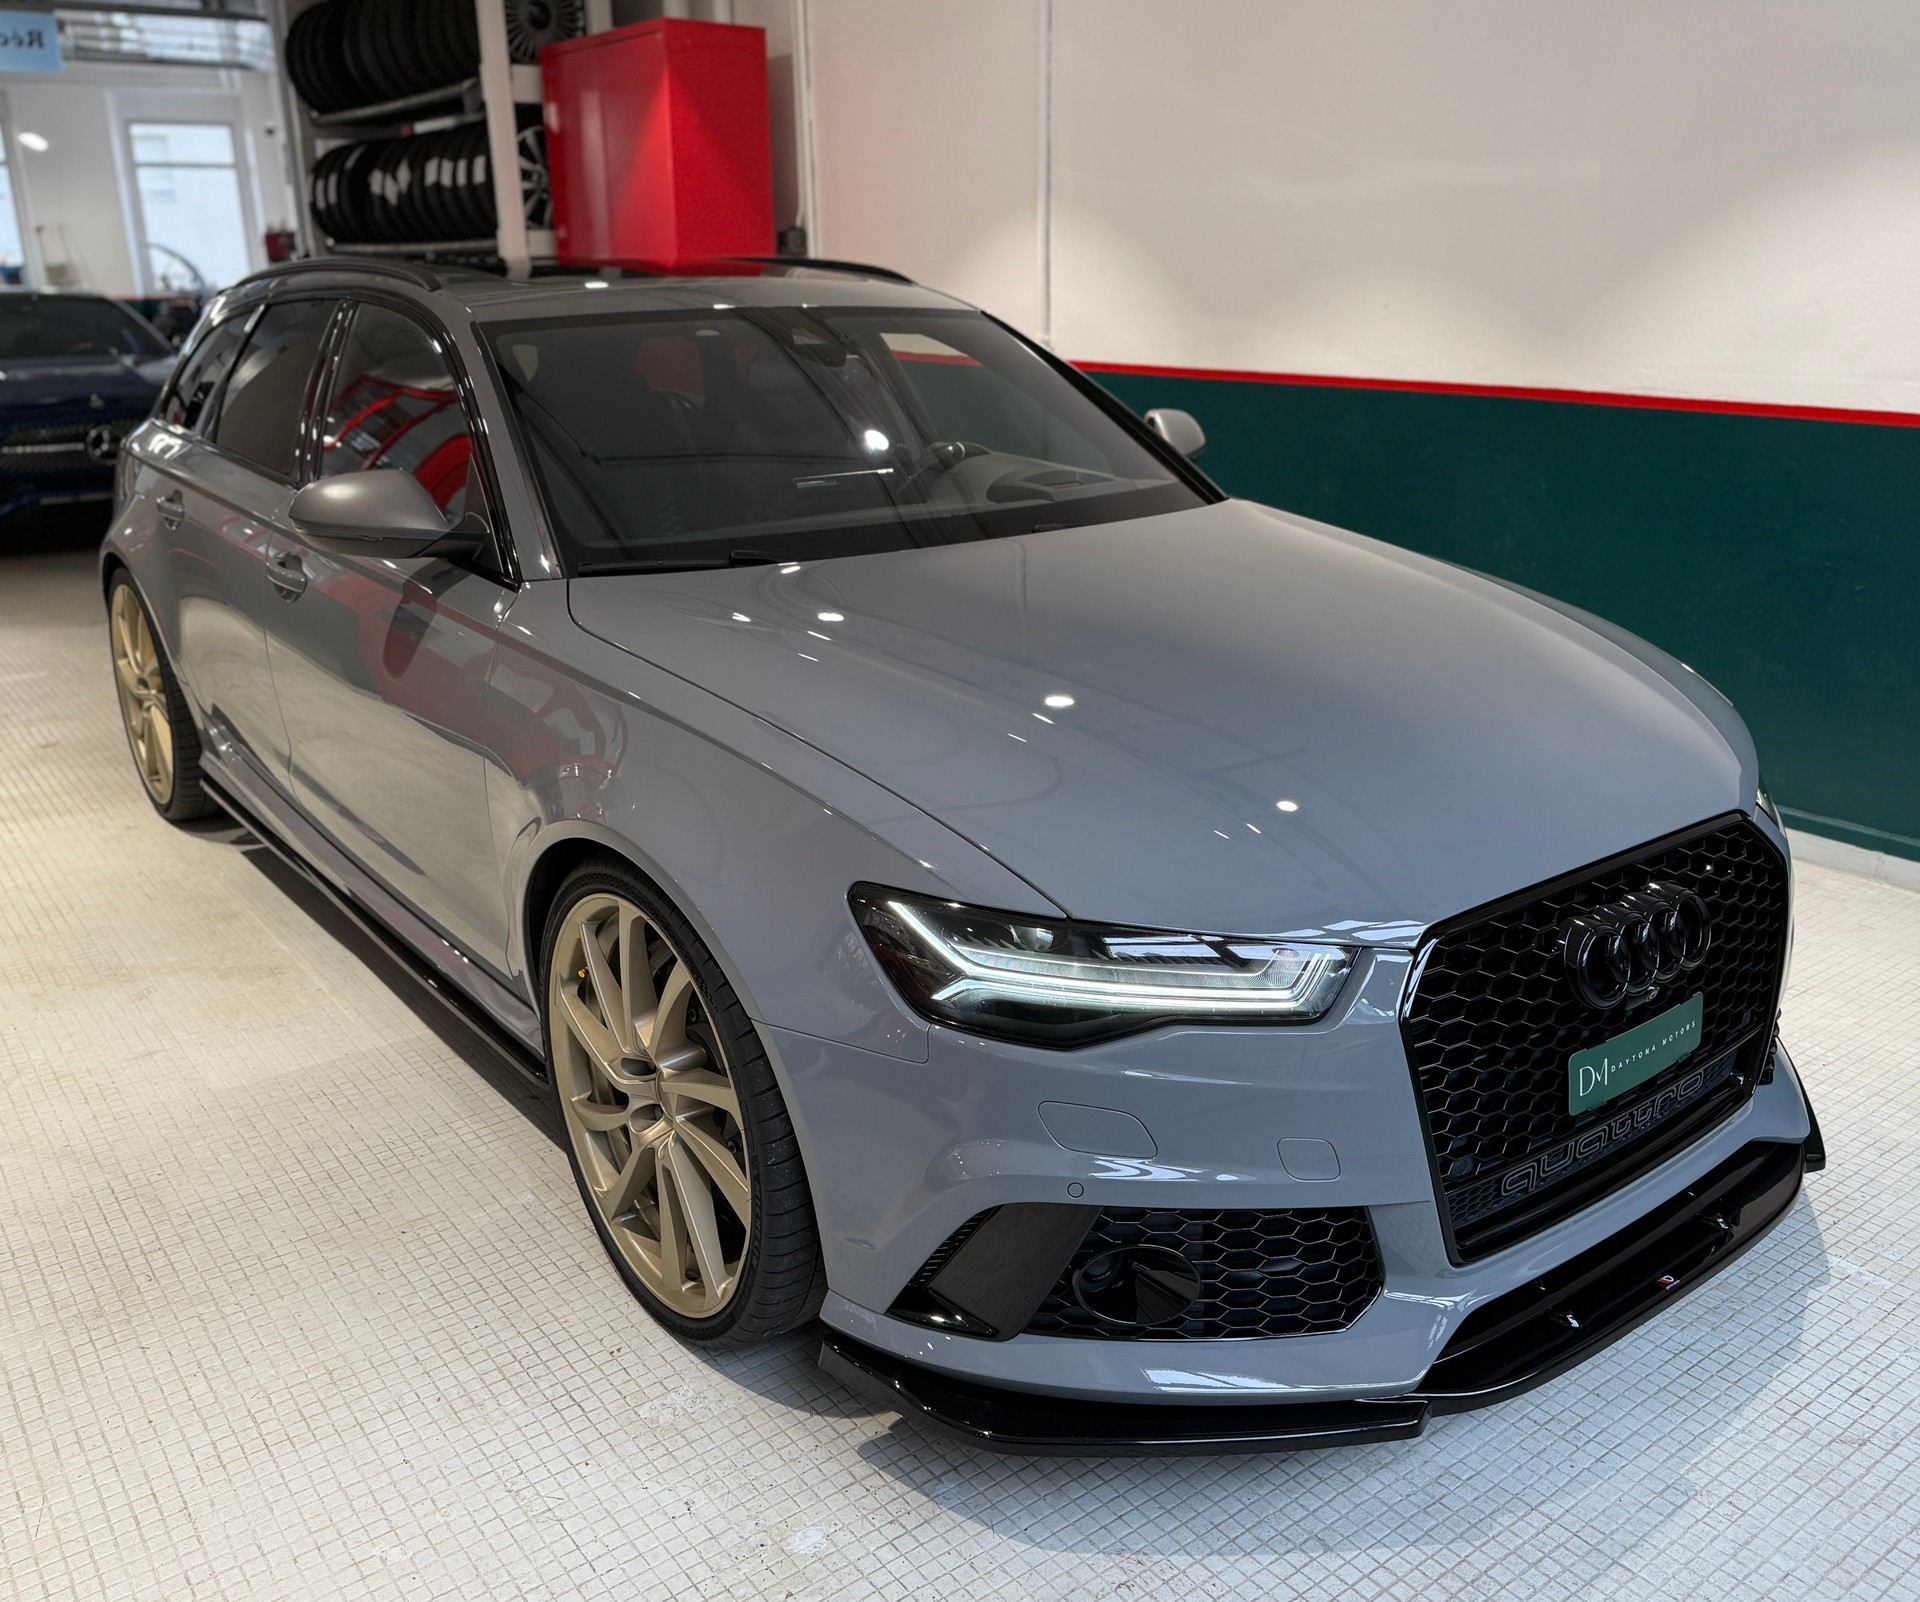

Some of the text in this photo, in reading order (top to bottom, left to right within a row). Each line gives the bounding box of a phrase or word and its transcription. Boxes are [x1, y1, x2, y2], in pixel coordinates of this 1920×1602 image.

[1611, 1020, 1696, 1073] DAYTONA MOTORS
[1501, 1070, 1704, 1196] quattro
